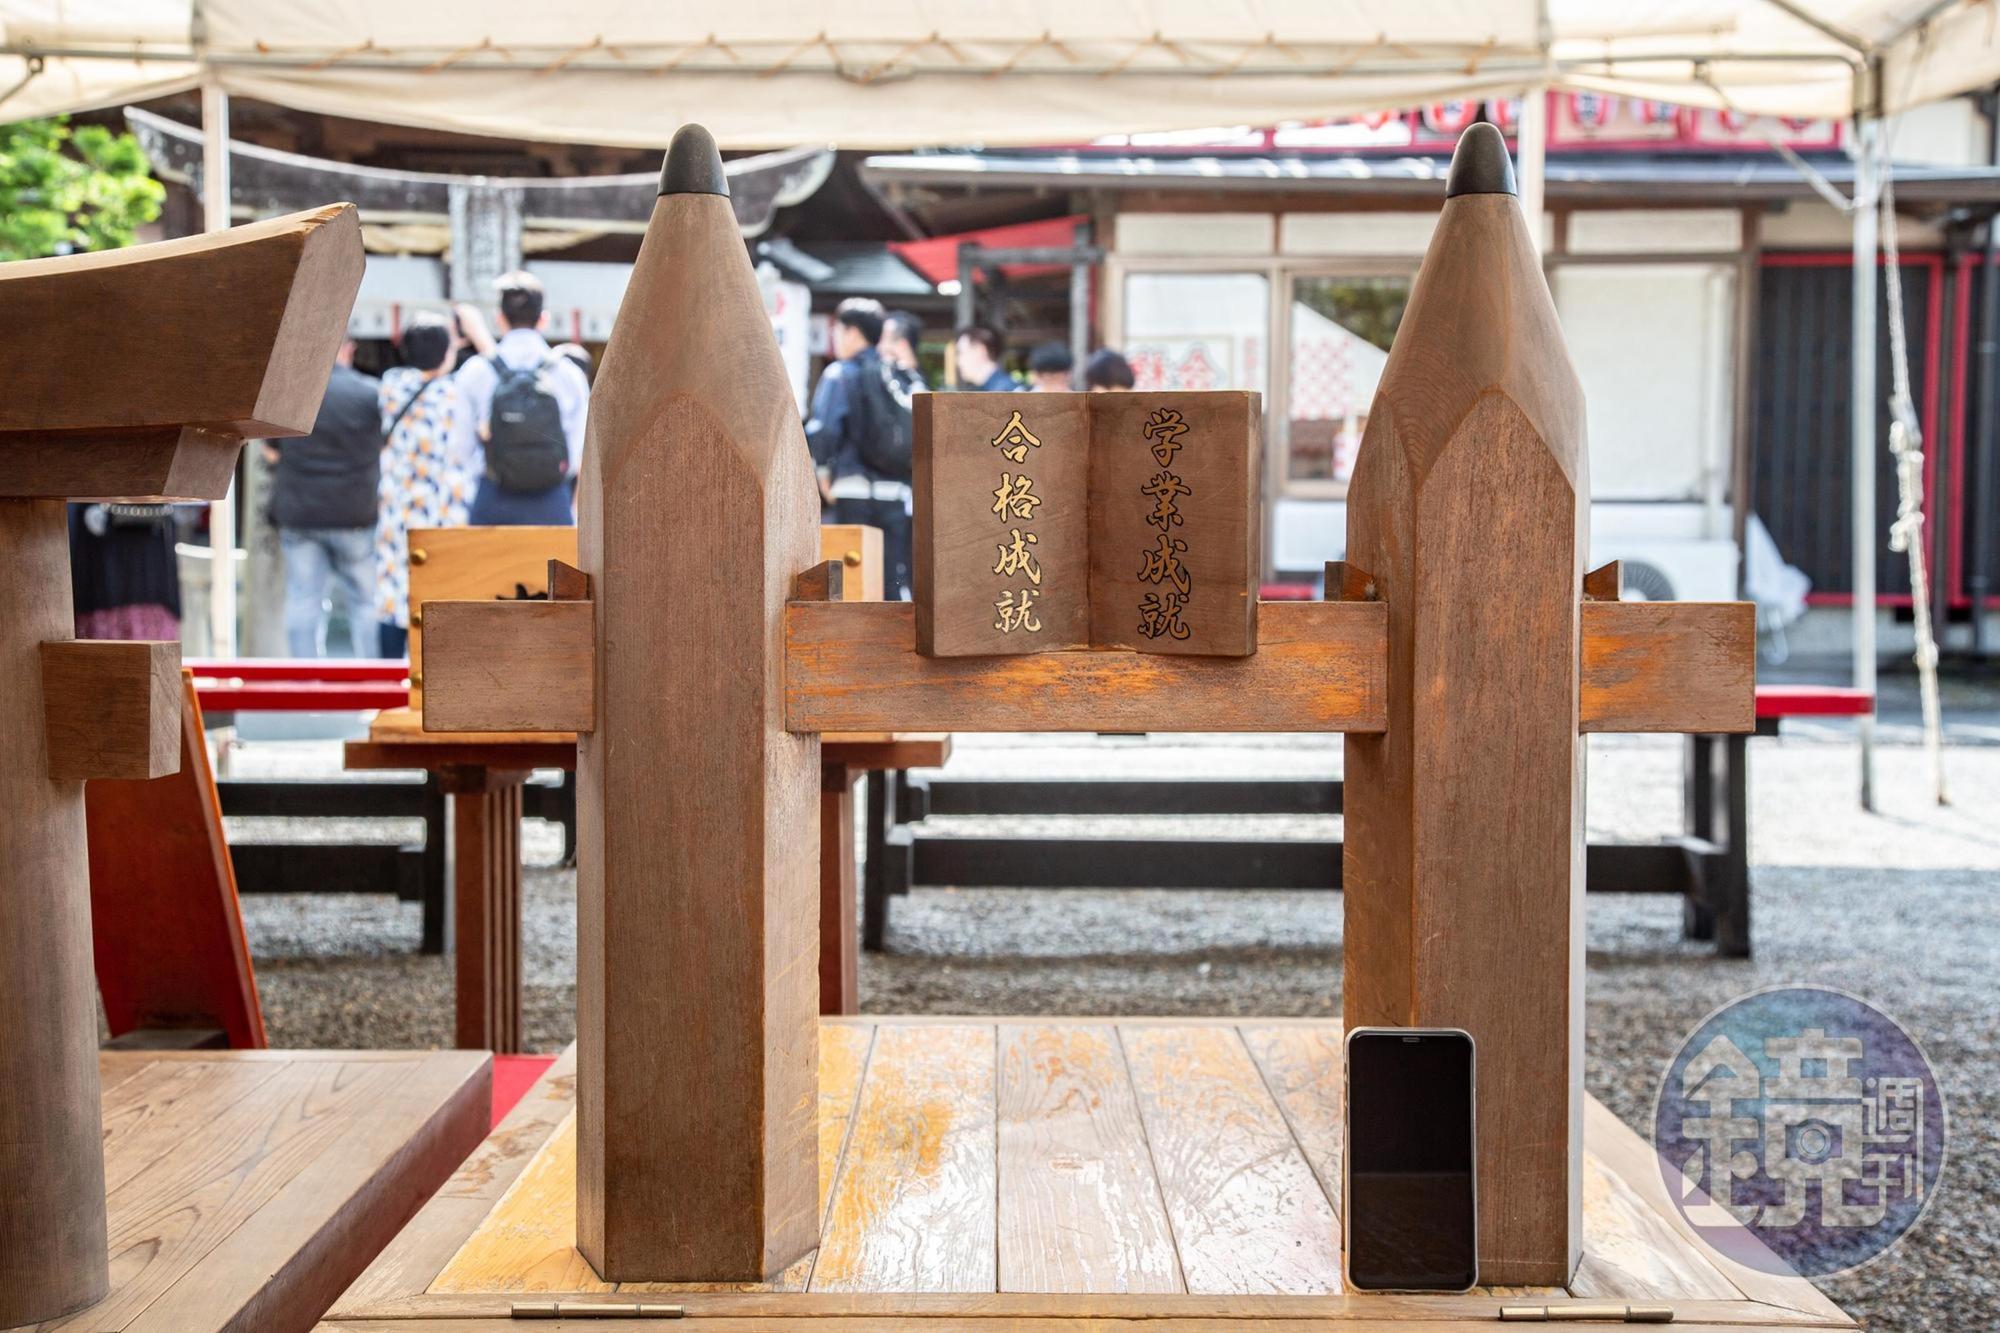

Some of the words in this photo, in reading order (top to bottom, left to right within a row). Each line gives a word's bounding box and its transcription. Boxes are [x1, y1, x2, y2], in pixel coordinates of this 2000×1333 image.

[991, 410, 1042, 634] 合格成就
[1137, 408, 1192, 640] 学業成就
